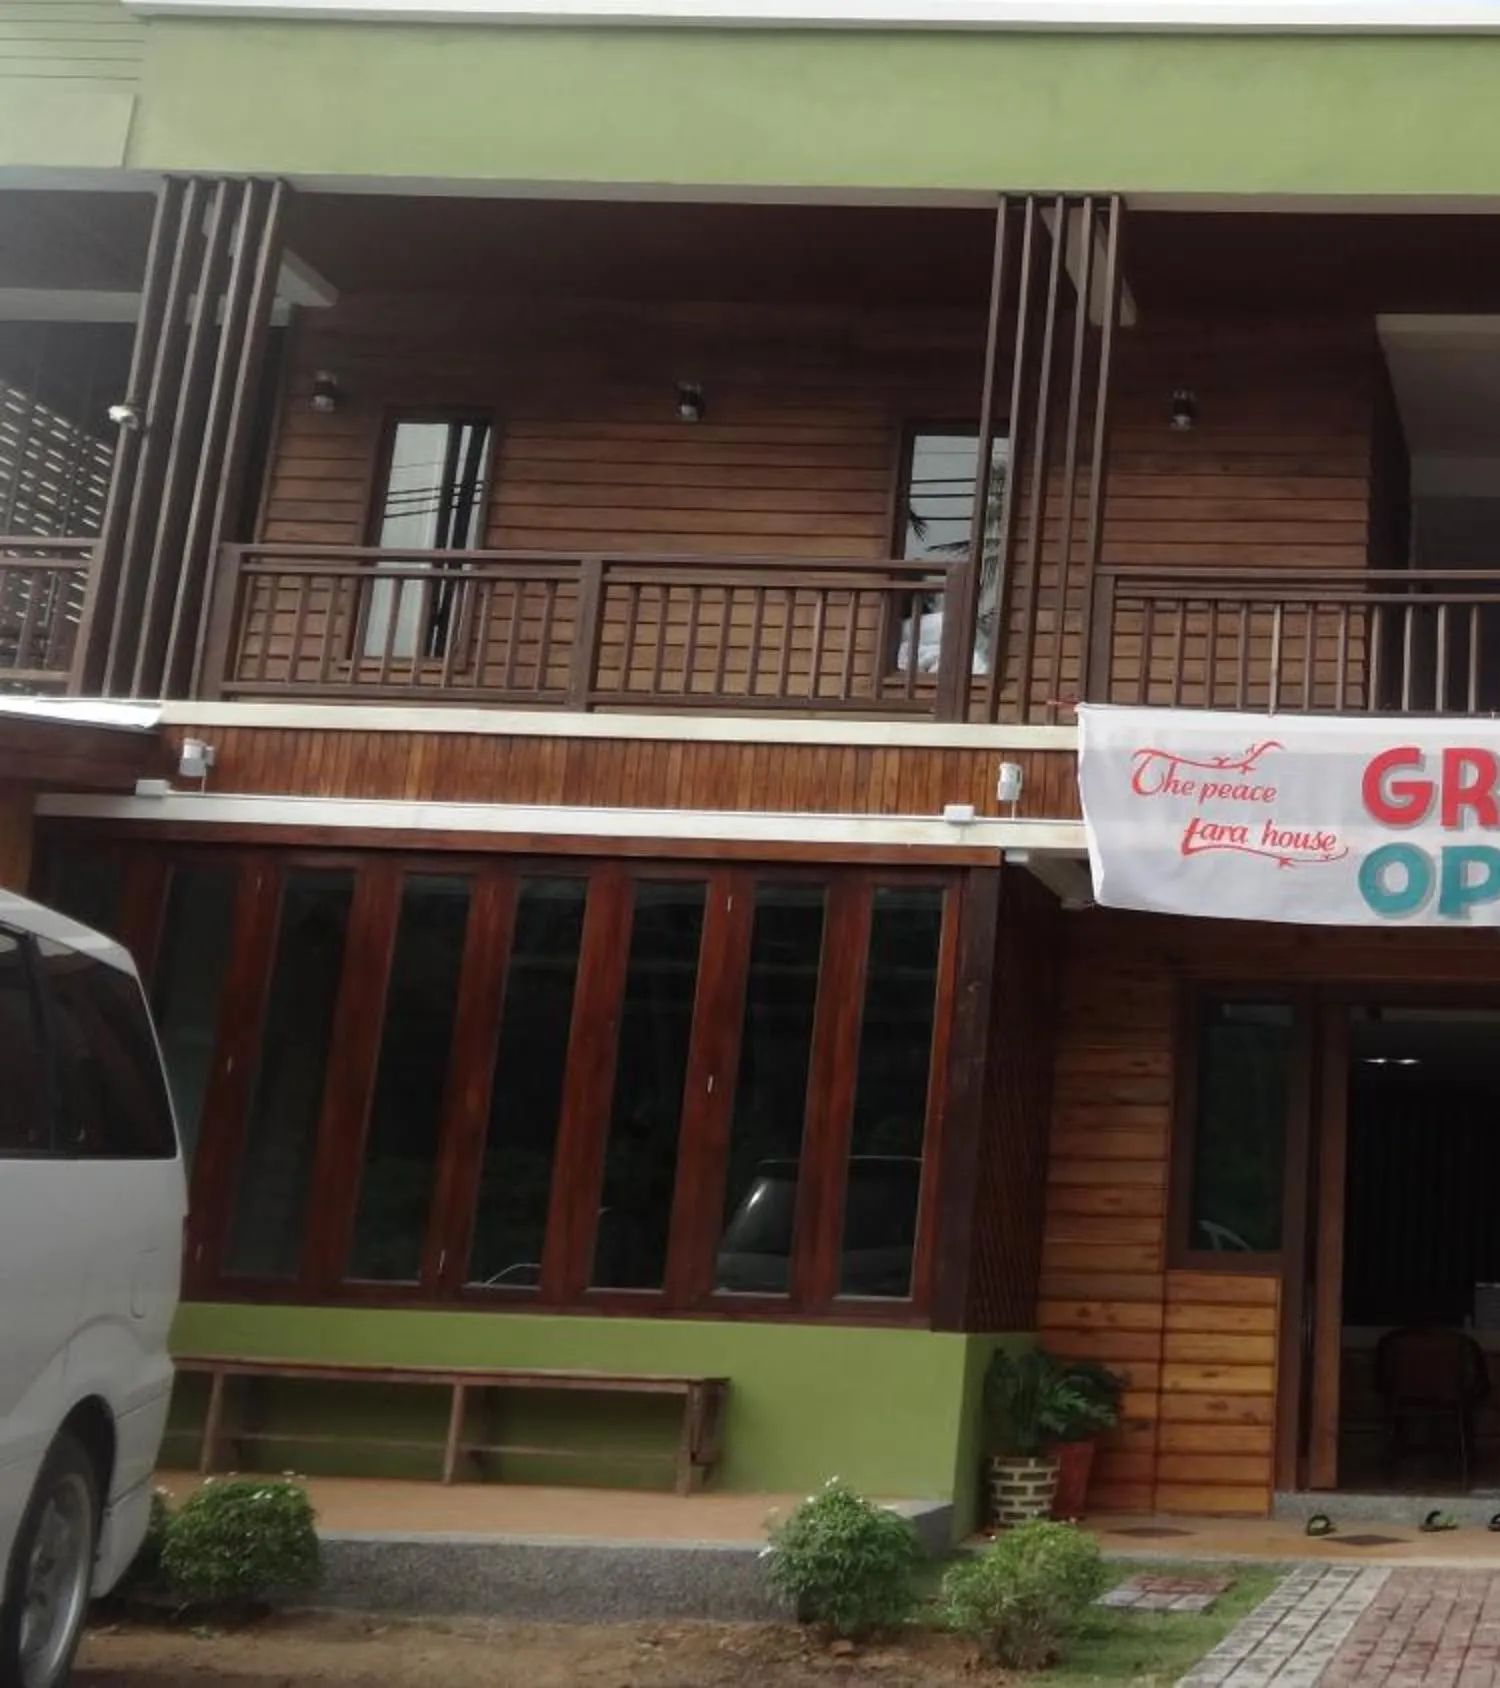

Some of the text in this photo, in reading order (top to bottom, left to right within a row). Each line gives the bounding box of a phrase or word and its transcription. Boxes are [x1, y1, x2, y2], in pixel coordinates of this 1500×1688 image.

[1131, 748, 1278, 804] The peace
[1261, 818, 1338, 851] house
